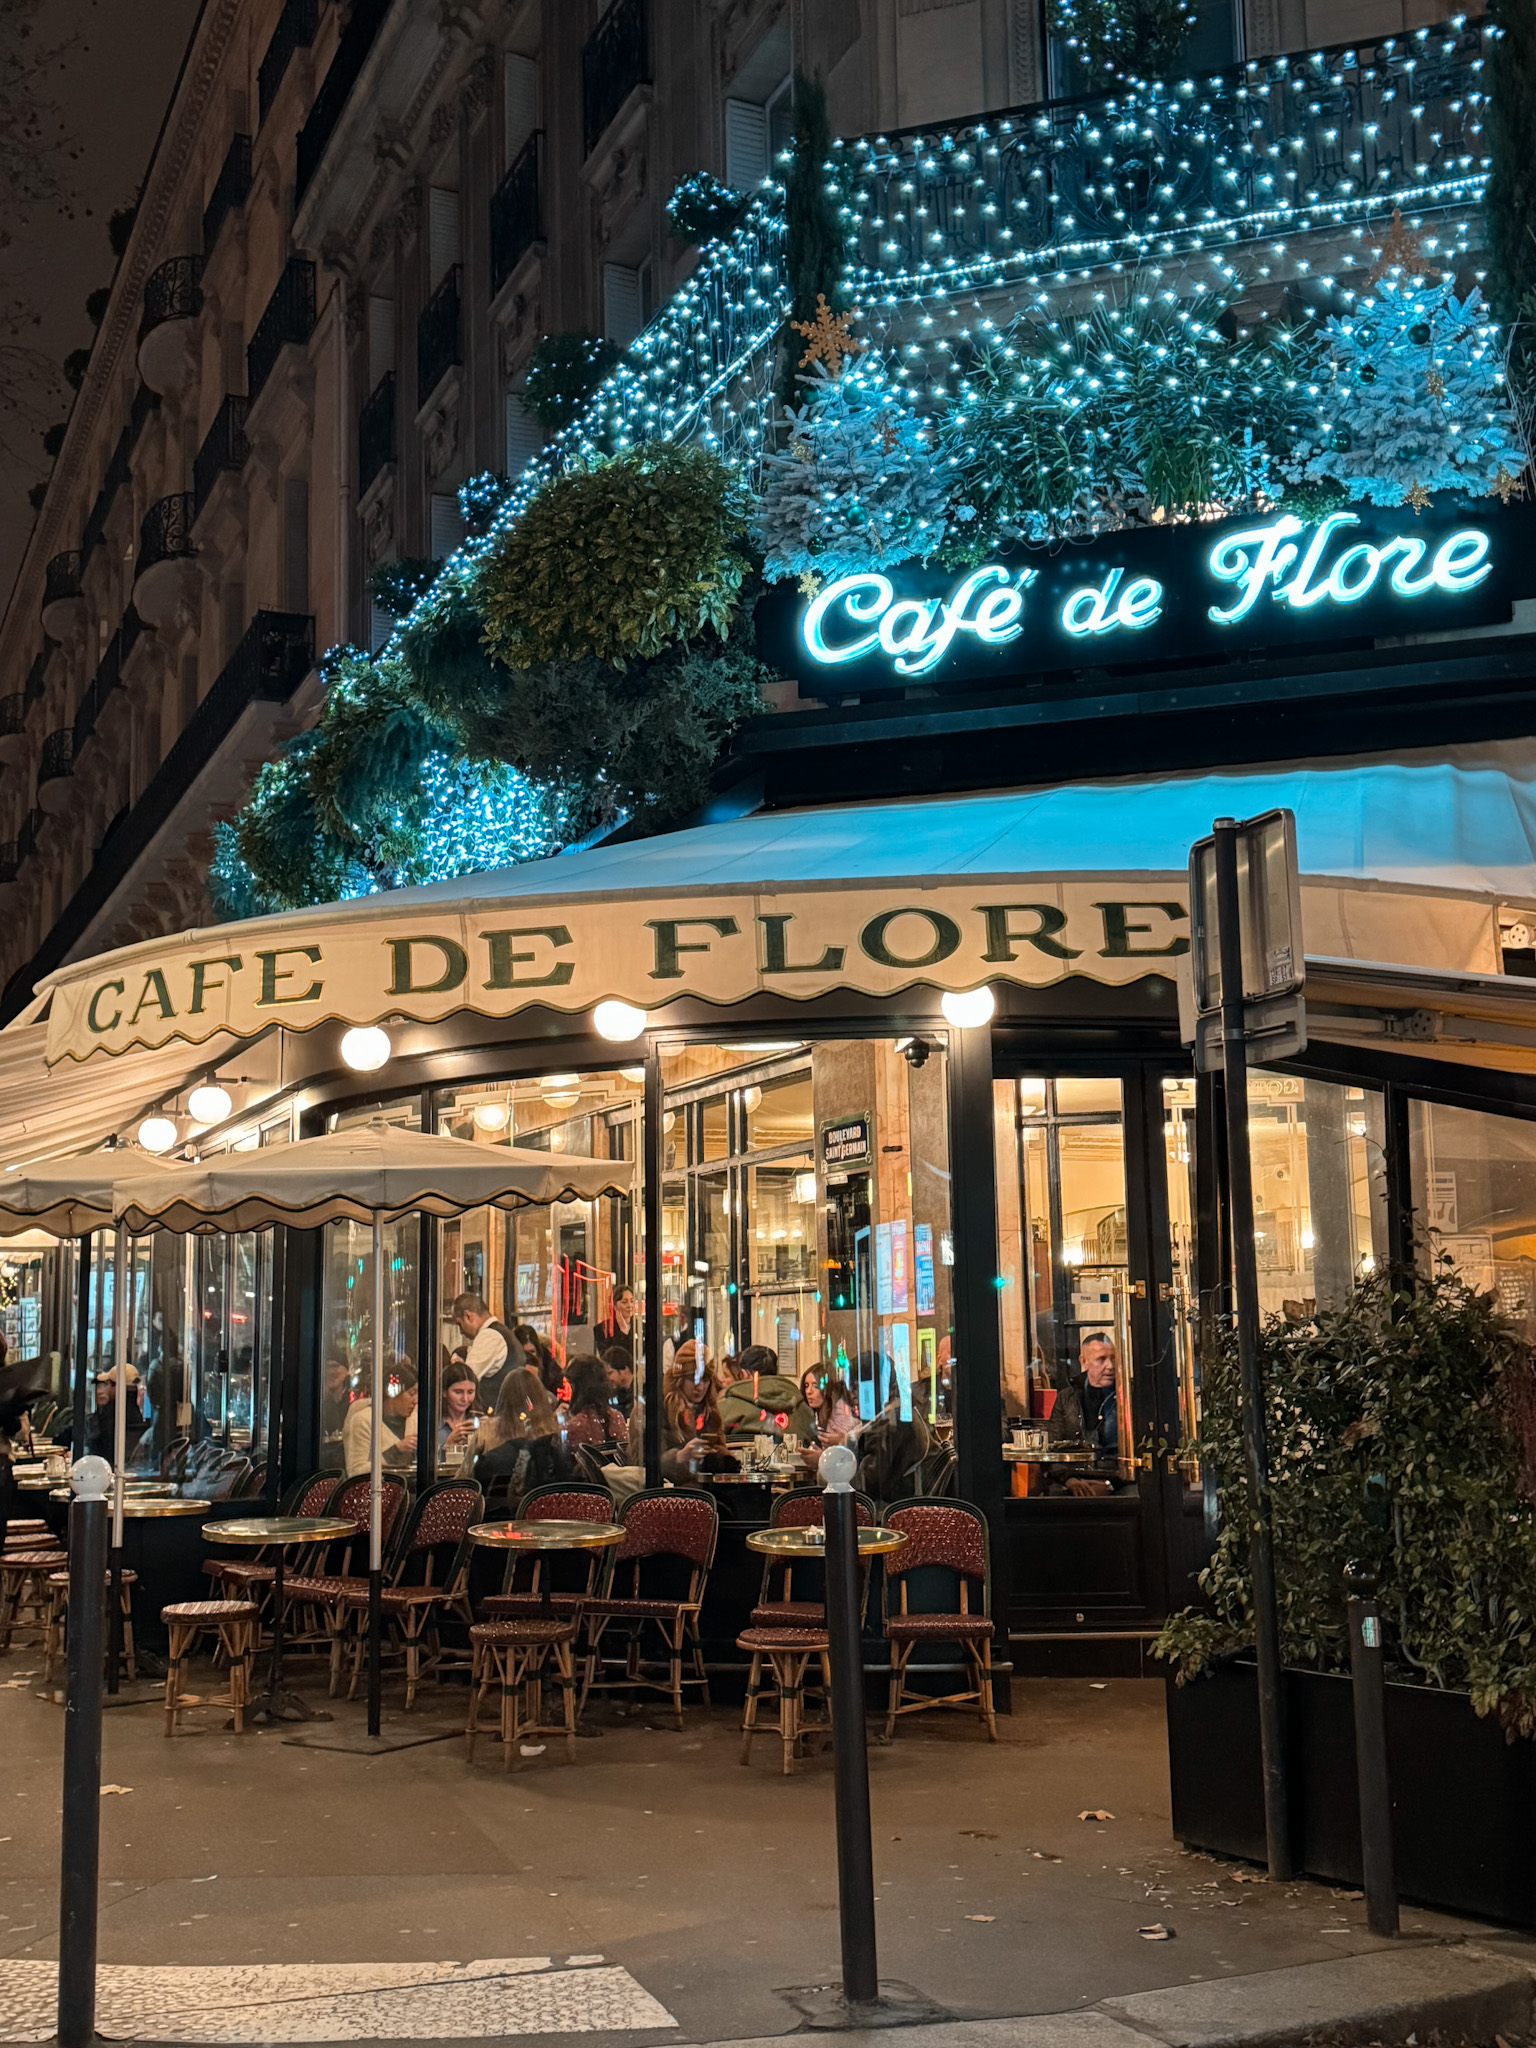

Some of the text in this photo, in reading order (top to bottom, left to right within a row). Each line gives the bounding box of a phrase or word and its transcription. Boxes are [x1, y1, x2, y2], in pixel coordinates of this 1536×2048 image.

[802, 510, 1493, 676] Café de Flore
[88, 902, 1190, 1035] CAFE DE FLORE
[828, 1125, 861, 1145] BOULEVARD
